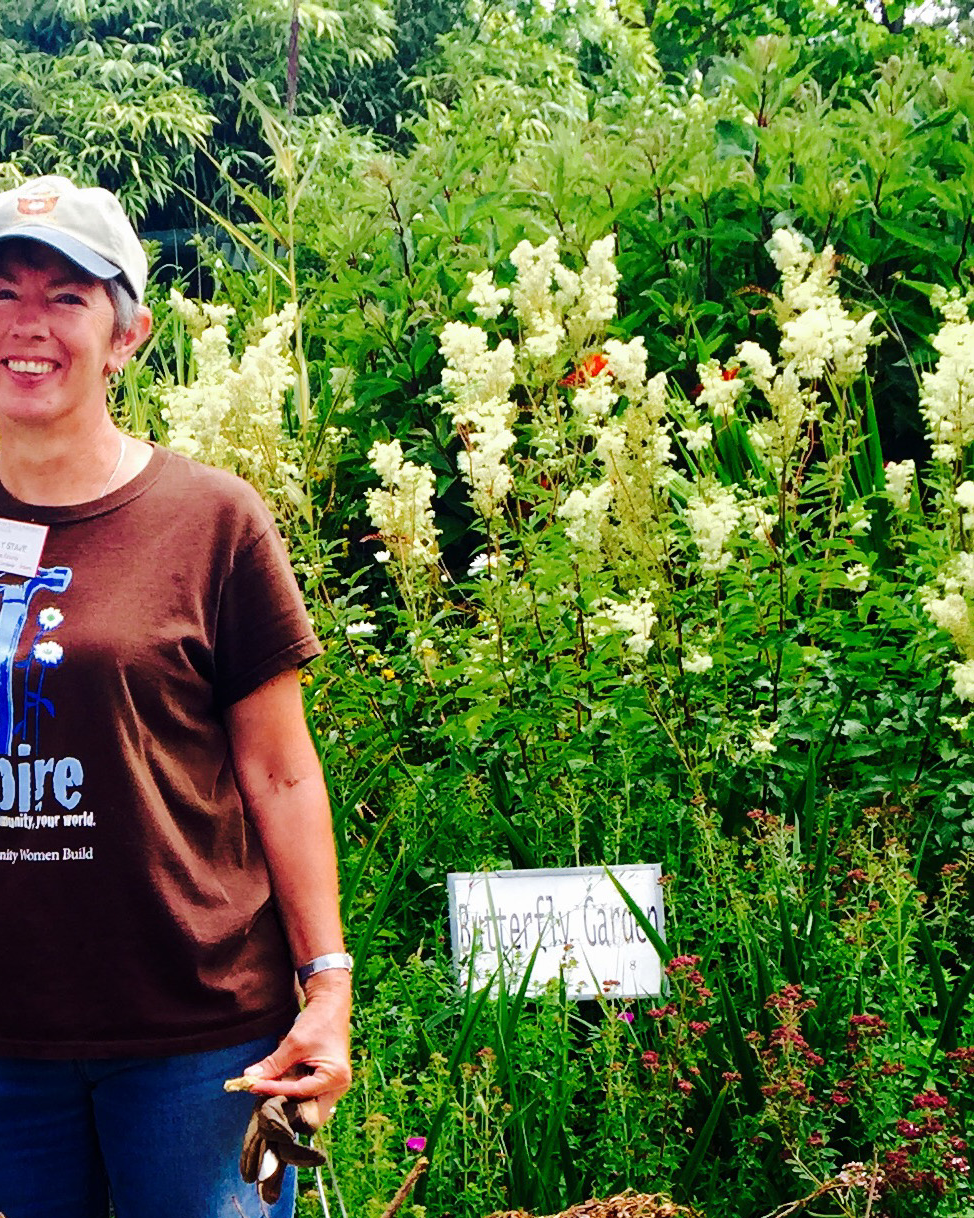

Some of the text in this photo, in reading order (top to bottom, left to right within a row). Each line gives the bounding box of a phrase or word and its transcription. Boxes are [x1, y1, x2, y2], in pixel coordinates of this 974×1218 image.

[63, 811, 96, 827] world.
[19, 848, 60, 860] Women
[62, 847, 94, 860] Build
